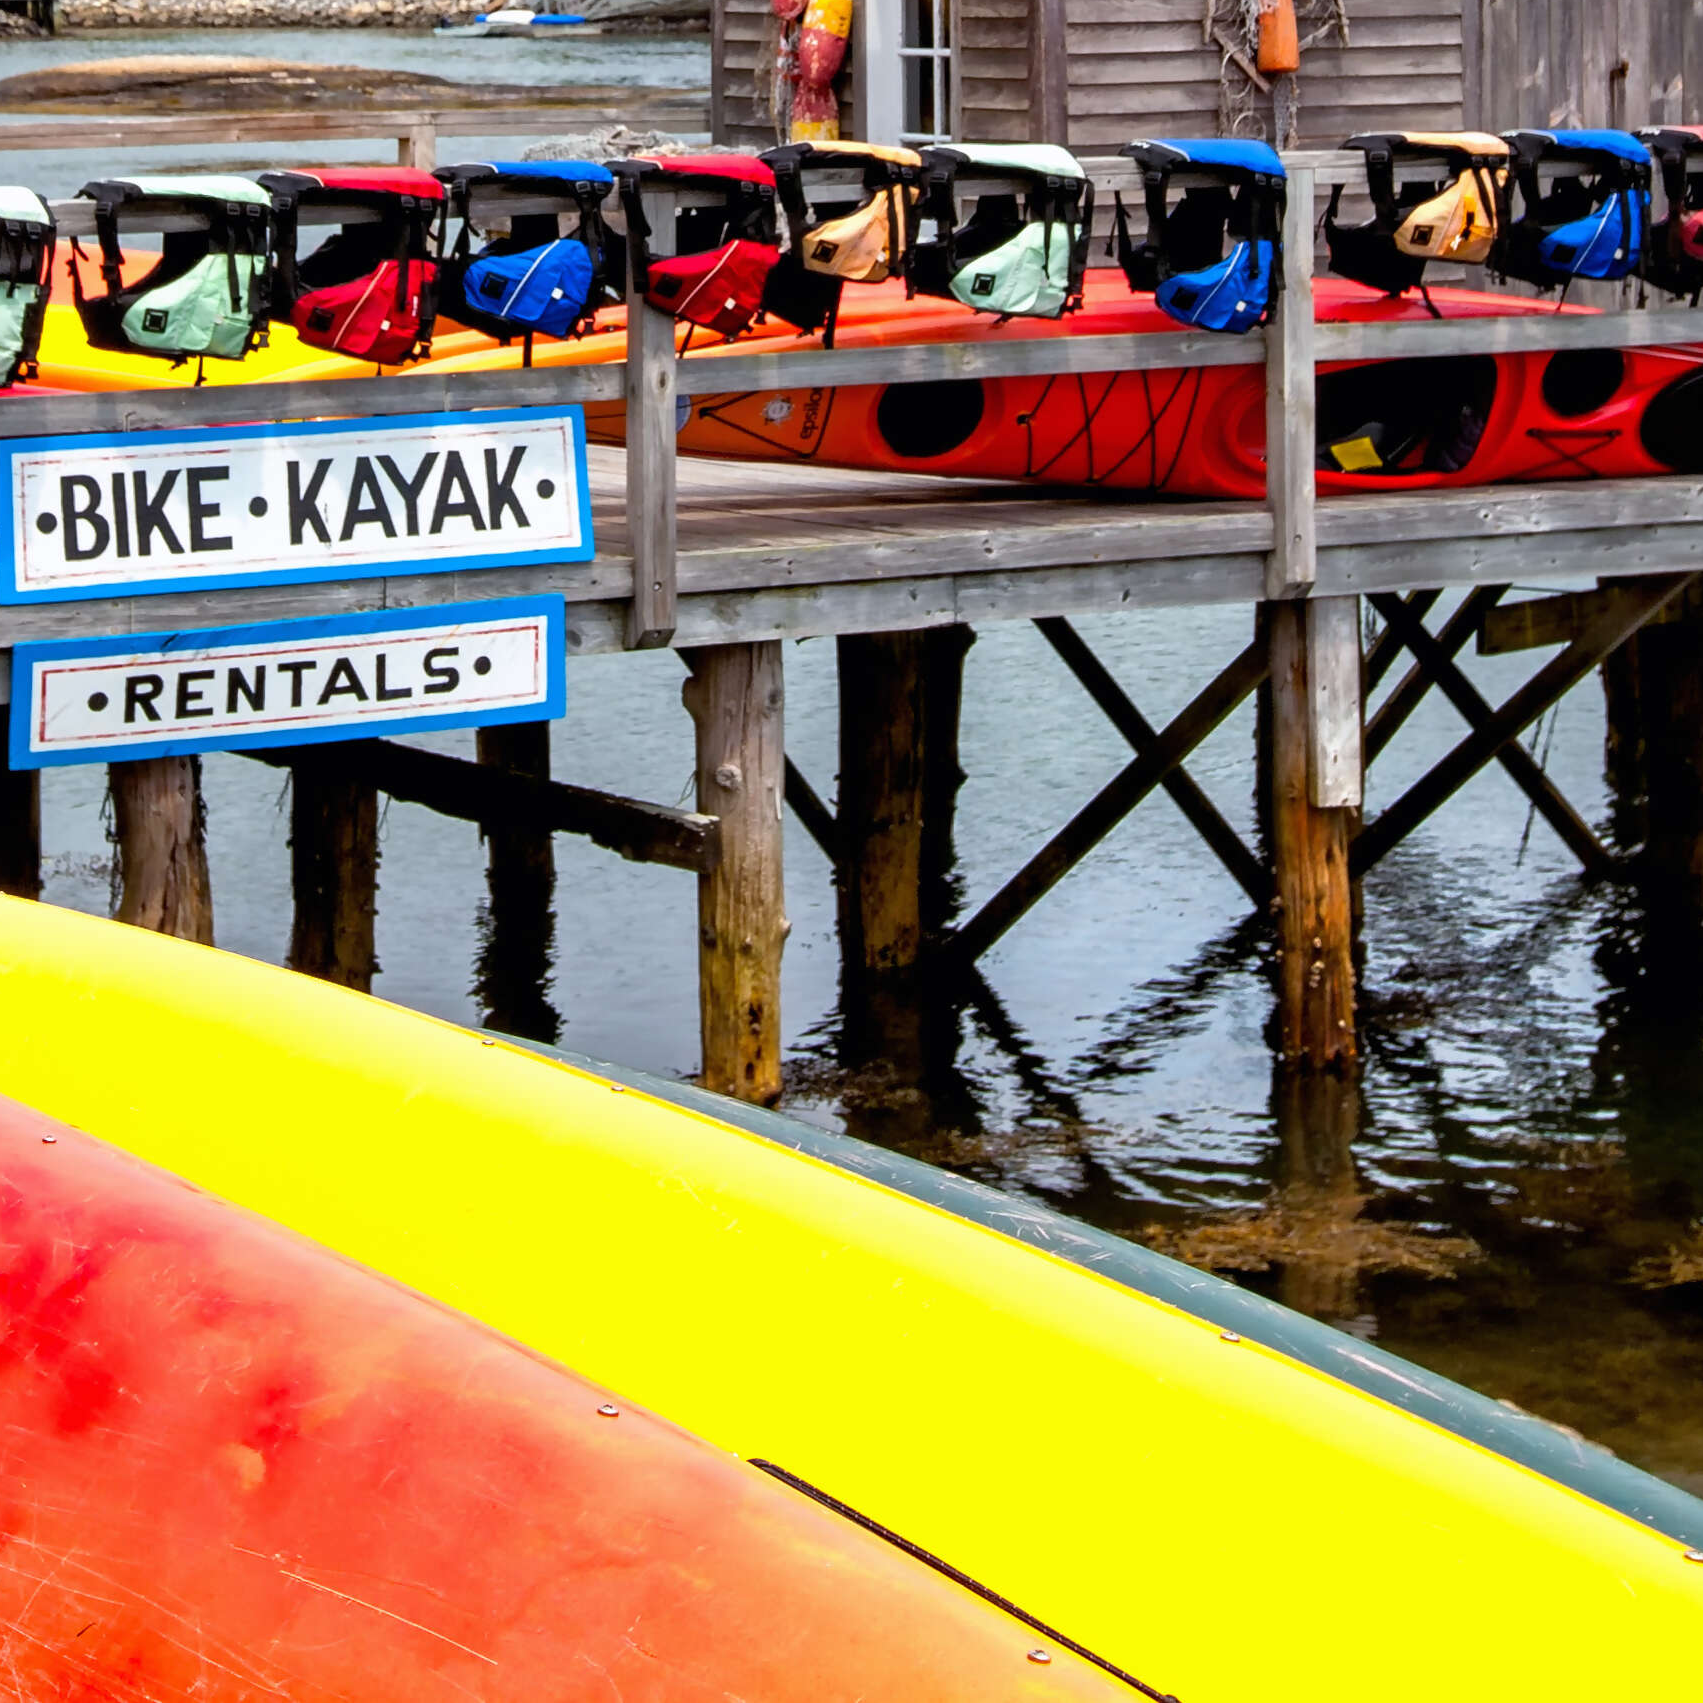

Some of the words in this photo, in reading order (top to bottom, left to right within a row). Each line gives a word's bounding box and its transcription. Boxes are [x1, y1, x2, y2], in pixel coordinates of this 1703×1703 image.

[59, 465, 234, 562] BIKE
[286, 444, 532, 546] KAYAK
[123, 646, 461, 724] RENTALS
